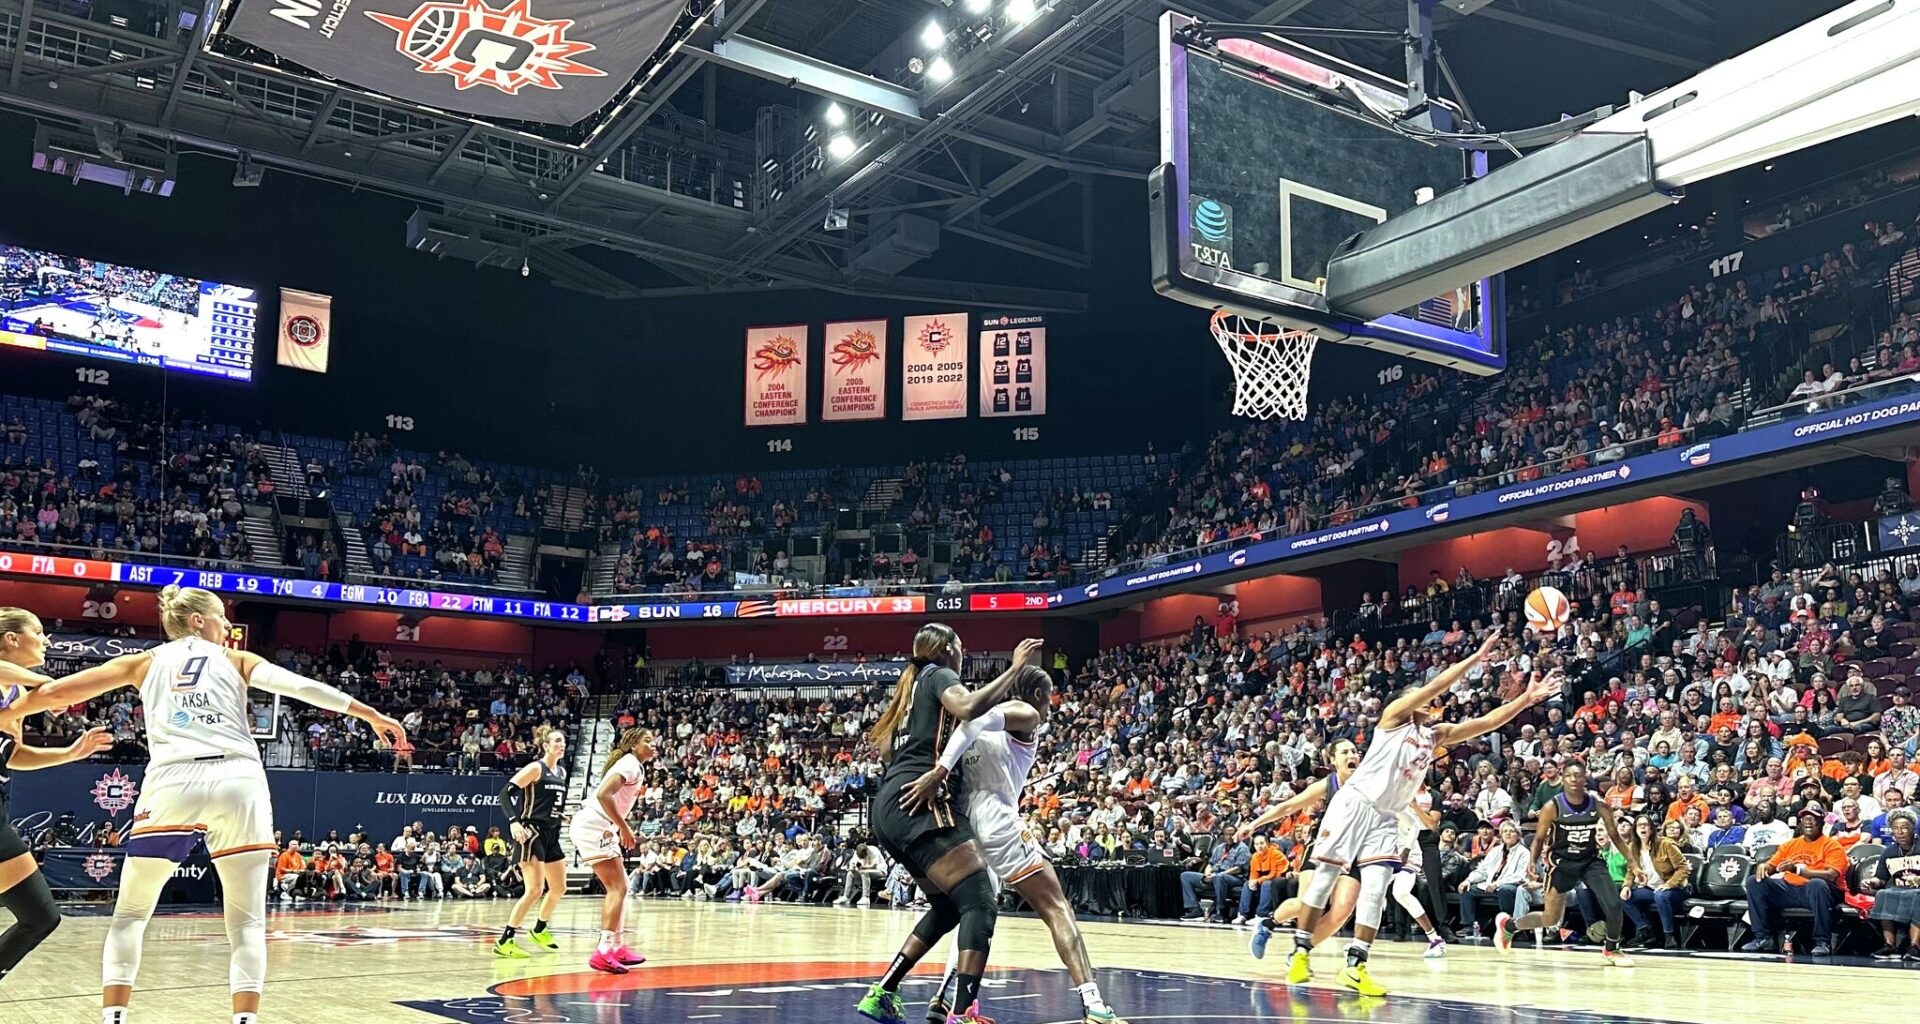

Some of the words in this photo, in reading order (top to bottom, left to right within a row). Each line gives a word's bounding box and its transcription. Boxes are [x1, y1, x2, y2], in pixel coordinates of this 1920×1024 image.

[270, 0, 322, 29] N
[1709, 251, 1744, 278] 117
[1010, 316, 1042, 325] LEGENDS
[996, 337, 1006, 346] 12
[1018, 335, 1030, 344] 42
[907, 363, 934, 373] 2004
[937, 362, 963, 371] 2005
[995, 364, 1007, 373] 23
[1019, 363, 1029, 371] 13
[75, 367, 109, 386] 112
[907, 375, 933, 384] 2019
[937, 373, 963, 383] 2022
[1377, 364, 1403, 385] 116
[767, 383, 785, 391] 2004
[845, 378, 863, 386] 2005
[760, 391, 792, 400] EASTERN
[838, 386, 870, 394] EASTERN
[997, 392, 1006, 401] 15
[753, 400, 798, 409] CONFERENCE
[831, 394, 877, 404] CONFERENCE
[754, 408, 796, 417] CHAMPIONS
[832, 403, 875, 412] CHAMPIONS
[386, 413, 414, 431] 113
[1794, 419, 1844, 437] OFFICIAL
[1844, 413, 1871, 426] HOT
[1871, 407, 1898, 420] DOG
[1012, 427, 1039, 440] 115
[767, 439, 792, 452] 114
[1498, 488, 1535, 503] OFFICIAL
[1535, 483, 1553, 495] HOT
[1554, 479, 1574, 490] DOG
[1574, 469, 1616, 486] PARTNER
[1290, 537, 1318, 549] OFFICIAL
[1318, 533, 1333, 544] HOT
[1332, 530, 1347, 540] DOG
[1347, 523, 1379, 537] PARTNER
[1546, 535, 1580, 562] 24
[31, 556, 55, 574] FTA
[73, 562, 86, 576] 0
[129, 566, 153, 582] AST
[172, 571, 185, 585] 7
[199, 572, 222, 588] REB
[236, 577, 259, 591] 19
[272, 578, 293, 595] T/O
[311, 586, 323, 596] 4
[340, 585, 365, 601] FGM
[377, 591, 398, 604] 10
[409, 592, 429, 607] FGA
[440, 596, 461, 609] 22
[472, 597, 493, 612] FTM
[504, 602, 522, 614] 11
[533, 603, 551, 617] FTA
[560, 607, 579, 619] 12
[780, 600, 878, 614] MERCURY
[892, 600, 912, 612] 33
[936, 597, 962, 610] 6:15
[989, 596, 998, 608] 5
[1025, 596, 1044, 606] 2ND
[82, 600, 117, 619] 20
[638, 606, 681, 618] SUN
[702, 605, 722, 617] 16
[395, 625, 420, 642] 21
[823, 635, 848, 650] 22
[171, 656, 208, 692] 9
[748, 664, 814, 683] Mohegan
[816, 664, 848, 678] Sun
[850, 663, 901, 678] Arena
[375, 791, 407, 804] LUX
[409, 792, 452, 805] BOND
[456, 794, 469, 806] &
[471, 794, 519, 807] GREN
[554, 791, 563, 806] 3
[1567, 830, 1590, 843] 22
